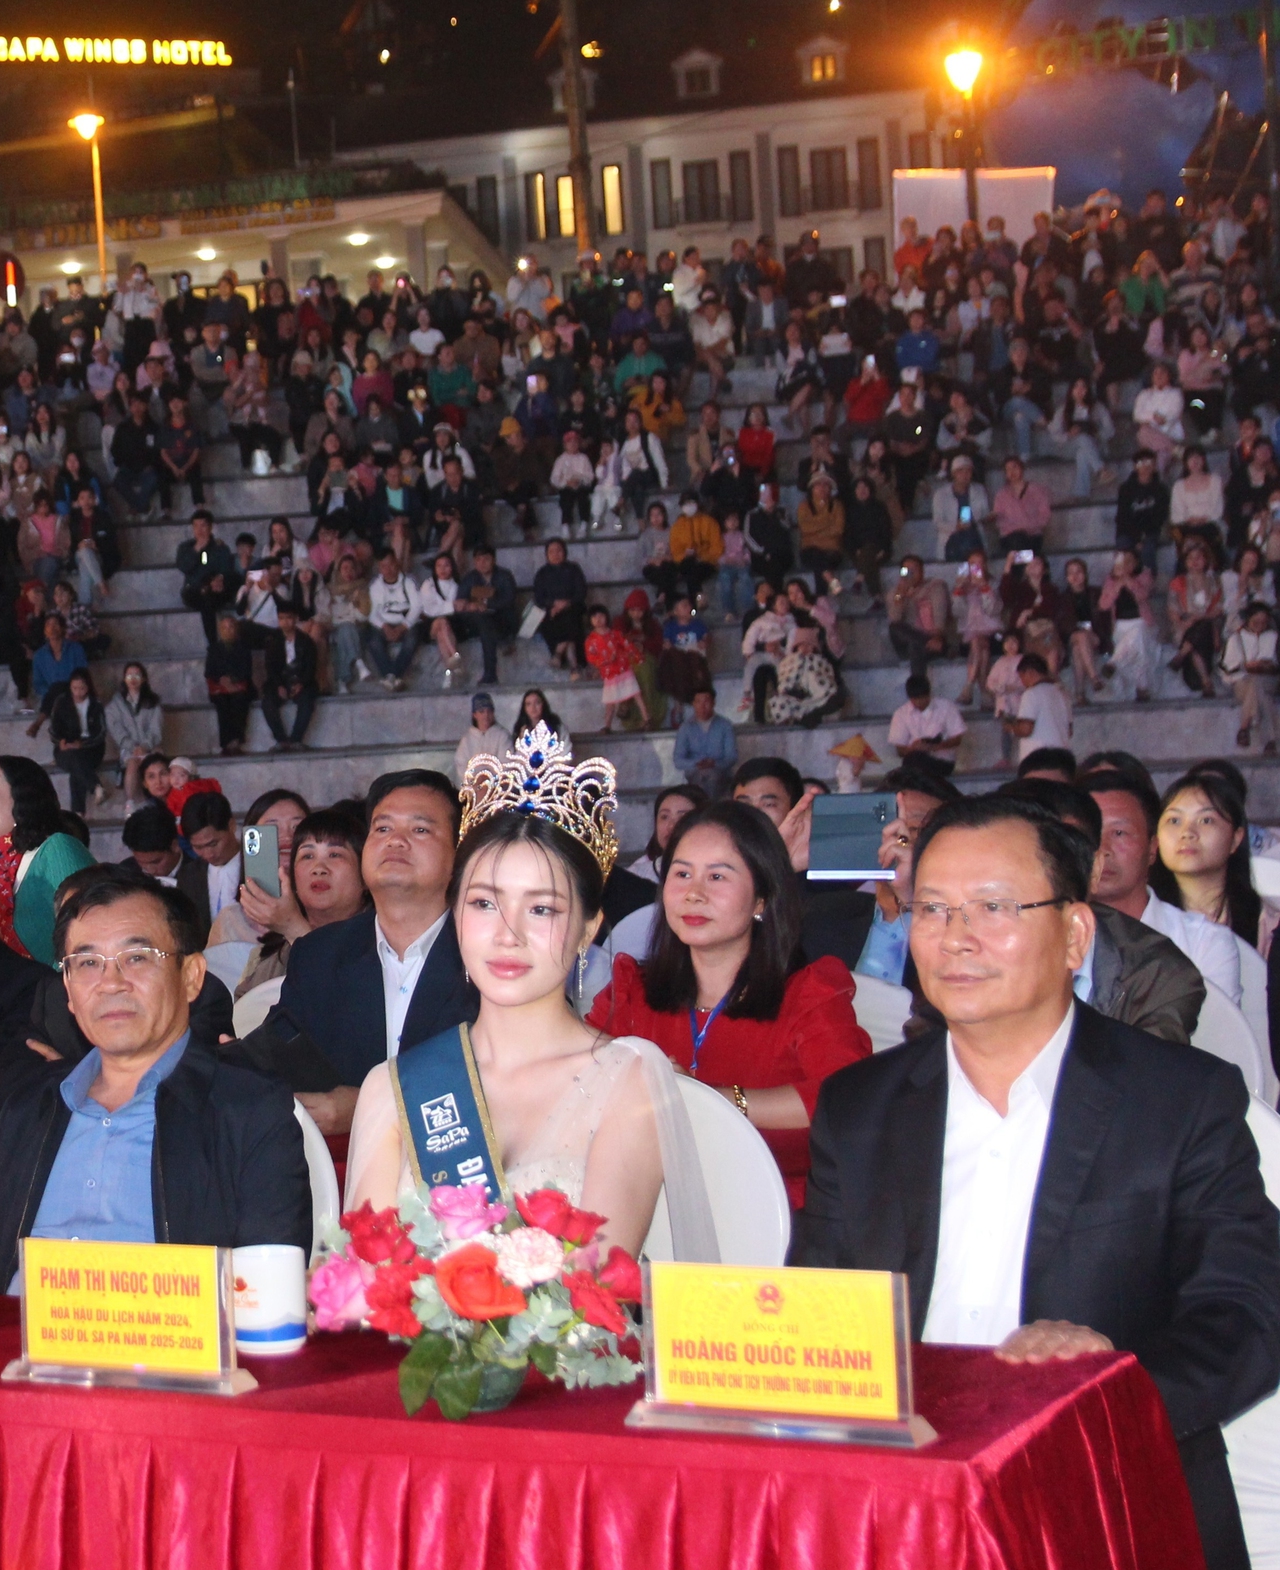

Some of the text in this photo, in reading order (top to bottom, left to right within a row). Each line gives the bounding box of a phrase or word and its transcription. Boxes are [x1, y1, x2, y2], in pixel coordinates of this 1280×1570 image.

[63, 37, 147, 64] WINGS
[152, 39, 233, 66] HOTEL
[426, 1126, 470, 1151] SaPa
[40, 1267, 201, 1299] PHẠM THỊ NGỌC QUỲNH
[50, 1306, 193, 1328] HOA HẬU DU LỊCH NĂM 2024,
[41, 1327, 58, 1343] ĐẠI
[77, 1329, 89, 1343] DL
[92, 1330, 105, 1344] SA
[108, 1331, 120, 1344] PA
[123, 1331, 147, 1346] NĂM
[151, 1335, 204, 1350] 2025-2026
[671, 1336, 873, 1370] HOÀNG QUỐC KHÁNH
